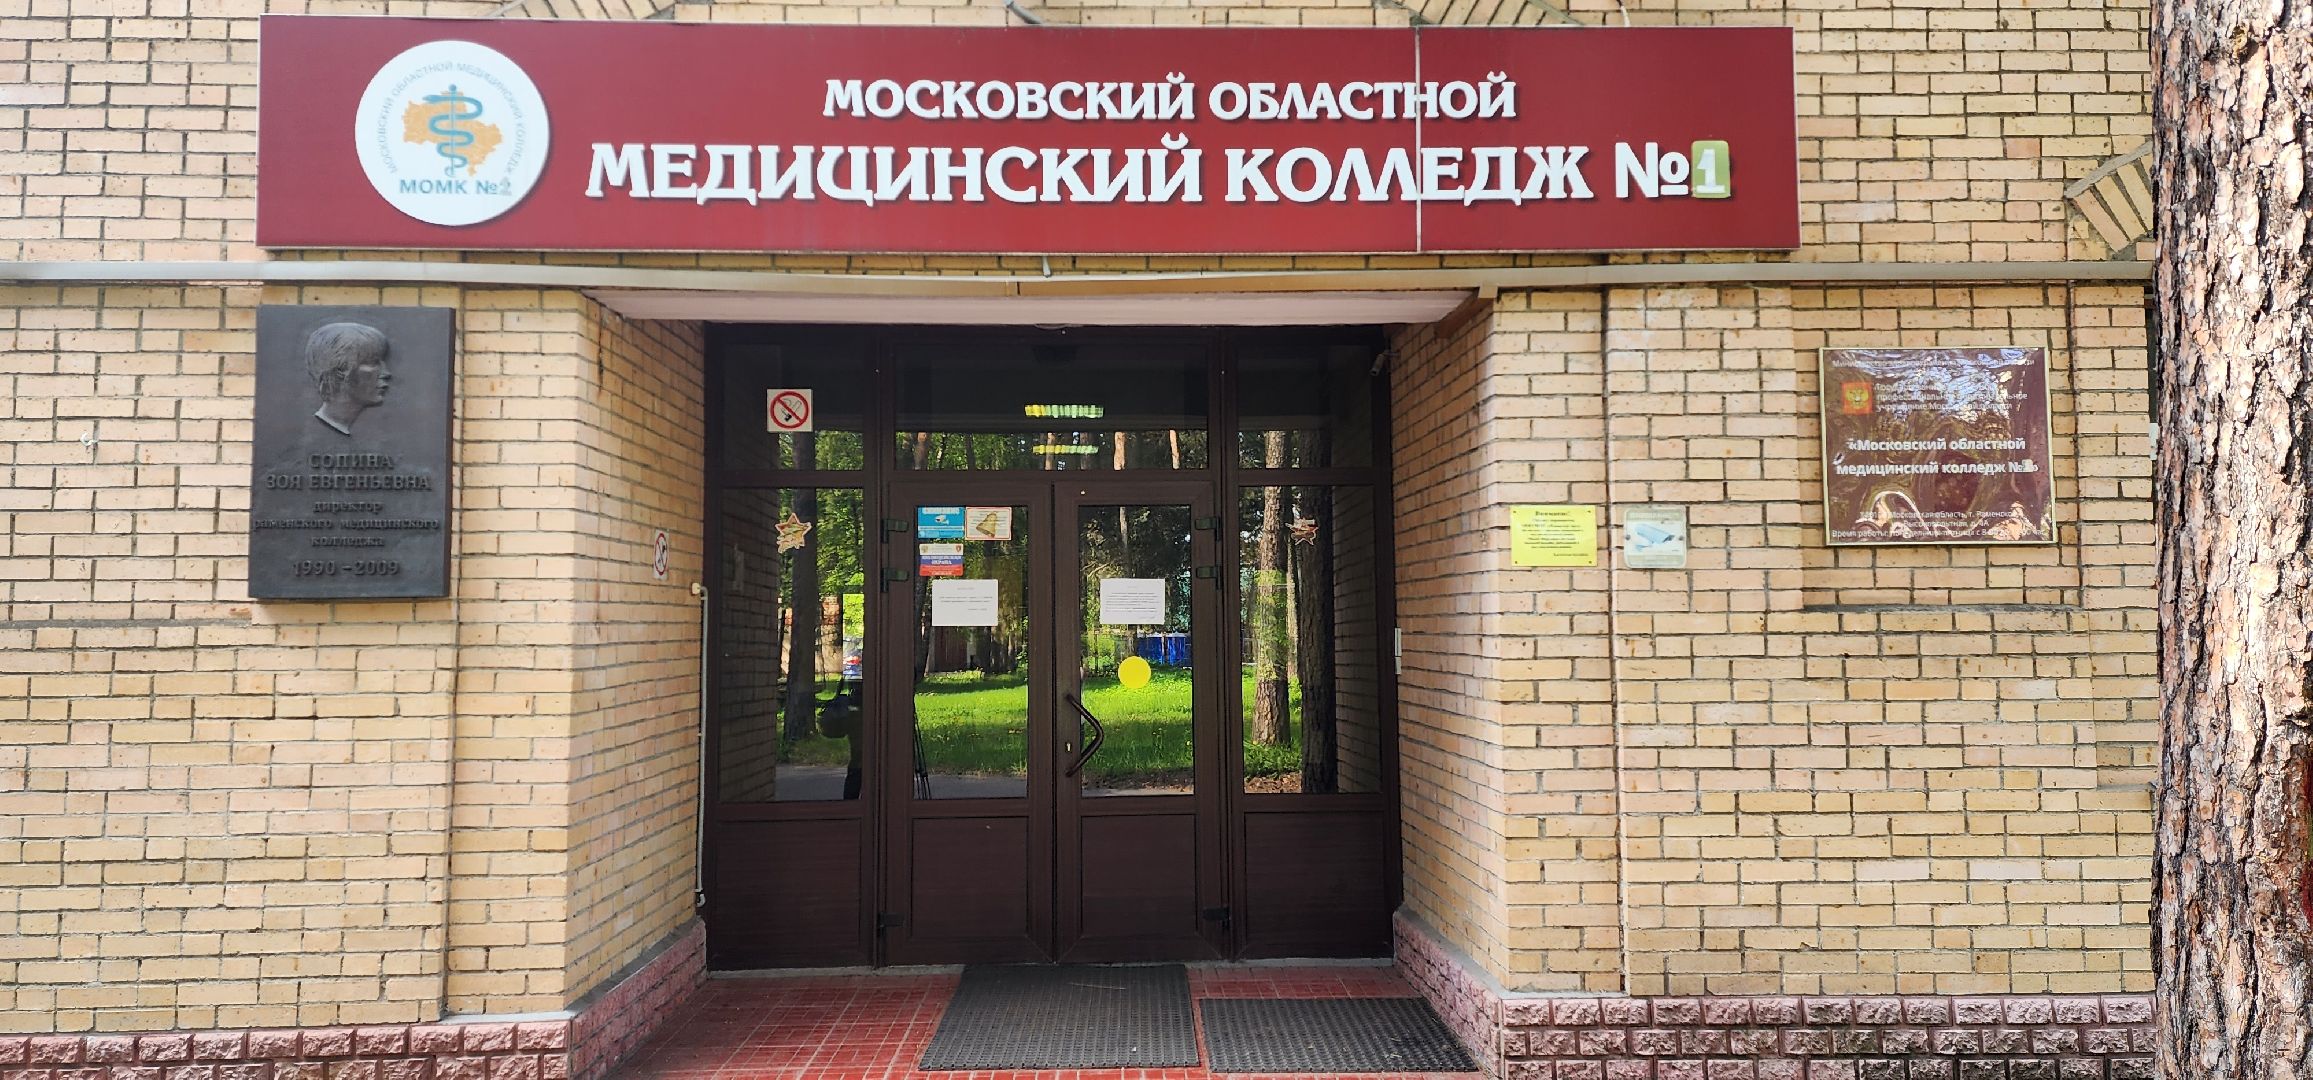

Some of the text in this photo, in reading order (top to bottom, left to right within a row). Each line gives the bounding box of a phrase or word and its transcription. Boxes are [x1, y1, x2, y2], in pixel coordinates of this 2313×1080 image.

[393, 61, 454, 98] ОБЛАСТНОЙ
[456, 62, 523, 121] МЕДИЦИНСКИЙ
[823, 71, 1517, 120] МОСКОВСКИЙ ОБЛАСТНОЙ
[584, 132, 1730, 207] МЕДИЦИНСКИЙ КОЛЛЕДЖ №1
[399, 179, 468, 195] МОМК
[1848, 437, 2026, 451] «Московский областной
[308, 453, 395, 470] СОПИНА
[1835, 461, 1939, 477] медицинский
[1941, 463, 2007, 477] колледж
[265, 474, 432, 491] ЗОЯ ЕВГЕНЬЕВНА
[312, 501, 384, 514] директор
[340, 518, 440, 531] медицинского
